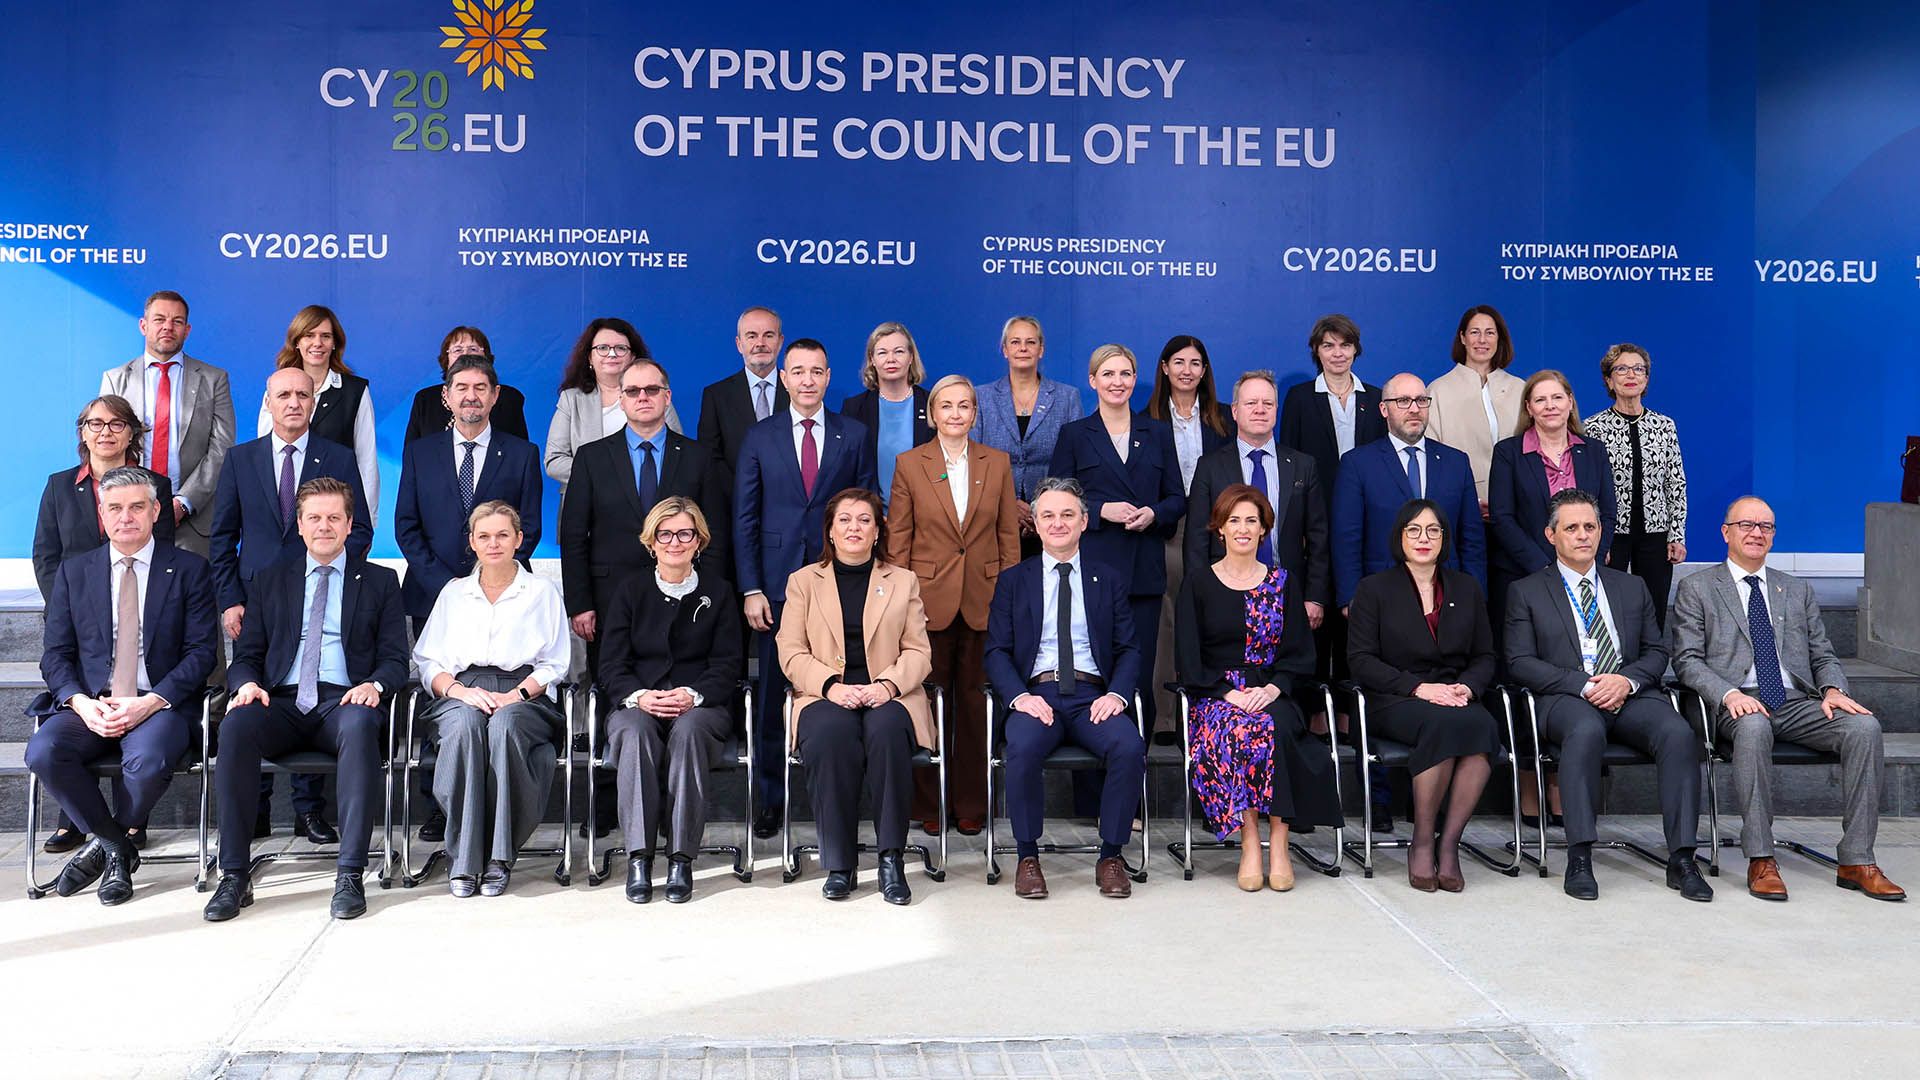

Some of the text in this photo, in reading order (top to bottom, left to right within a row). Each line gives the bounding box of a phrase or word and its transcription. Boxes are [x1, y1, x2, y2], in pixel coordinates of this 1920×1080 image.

[633, 46, 1186, 99] CYPRUS PRESIDENCY
[633, 114, 1336, 169] OF THE COUNCIL OF THE EU
[458, 227, 651, 245] ΚΥΠΡΙΑΚΗ ΠΡΟΕΔΡΙΑ
[982, 236, 1167, 254] CYPRUS PRESIDENCY
[0, 246, 147, 265] NCIL OF THE EU
[219, 232, 388, 260] CY2026.EU
[756, 238, 916, 266] CY2026.EU
[1501, 243, 1679, 260] ΚΥΠΡΙΑΚΗ ΠΡΟΕΔΡΙΑ
[458, 250, 688, 268] ΤΟΥ ΣΥΜΒΟΥΛΙΟΥ ΤΗΣ ΕΕ
[982, 258, 1217, 277] OF THE COUNCIL OF THE EU
[1282, 246, 1437, 273] CY2026.EU
[1500, 265, 1714, 282] ΤΟΥ ΣΥΜΒΟΥΛΙΟΥ ΤΗΣ ΕΕ
[1753, 259, 1877, 283] Y2026.EU
